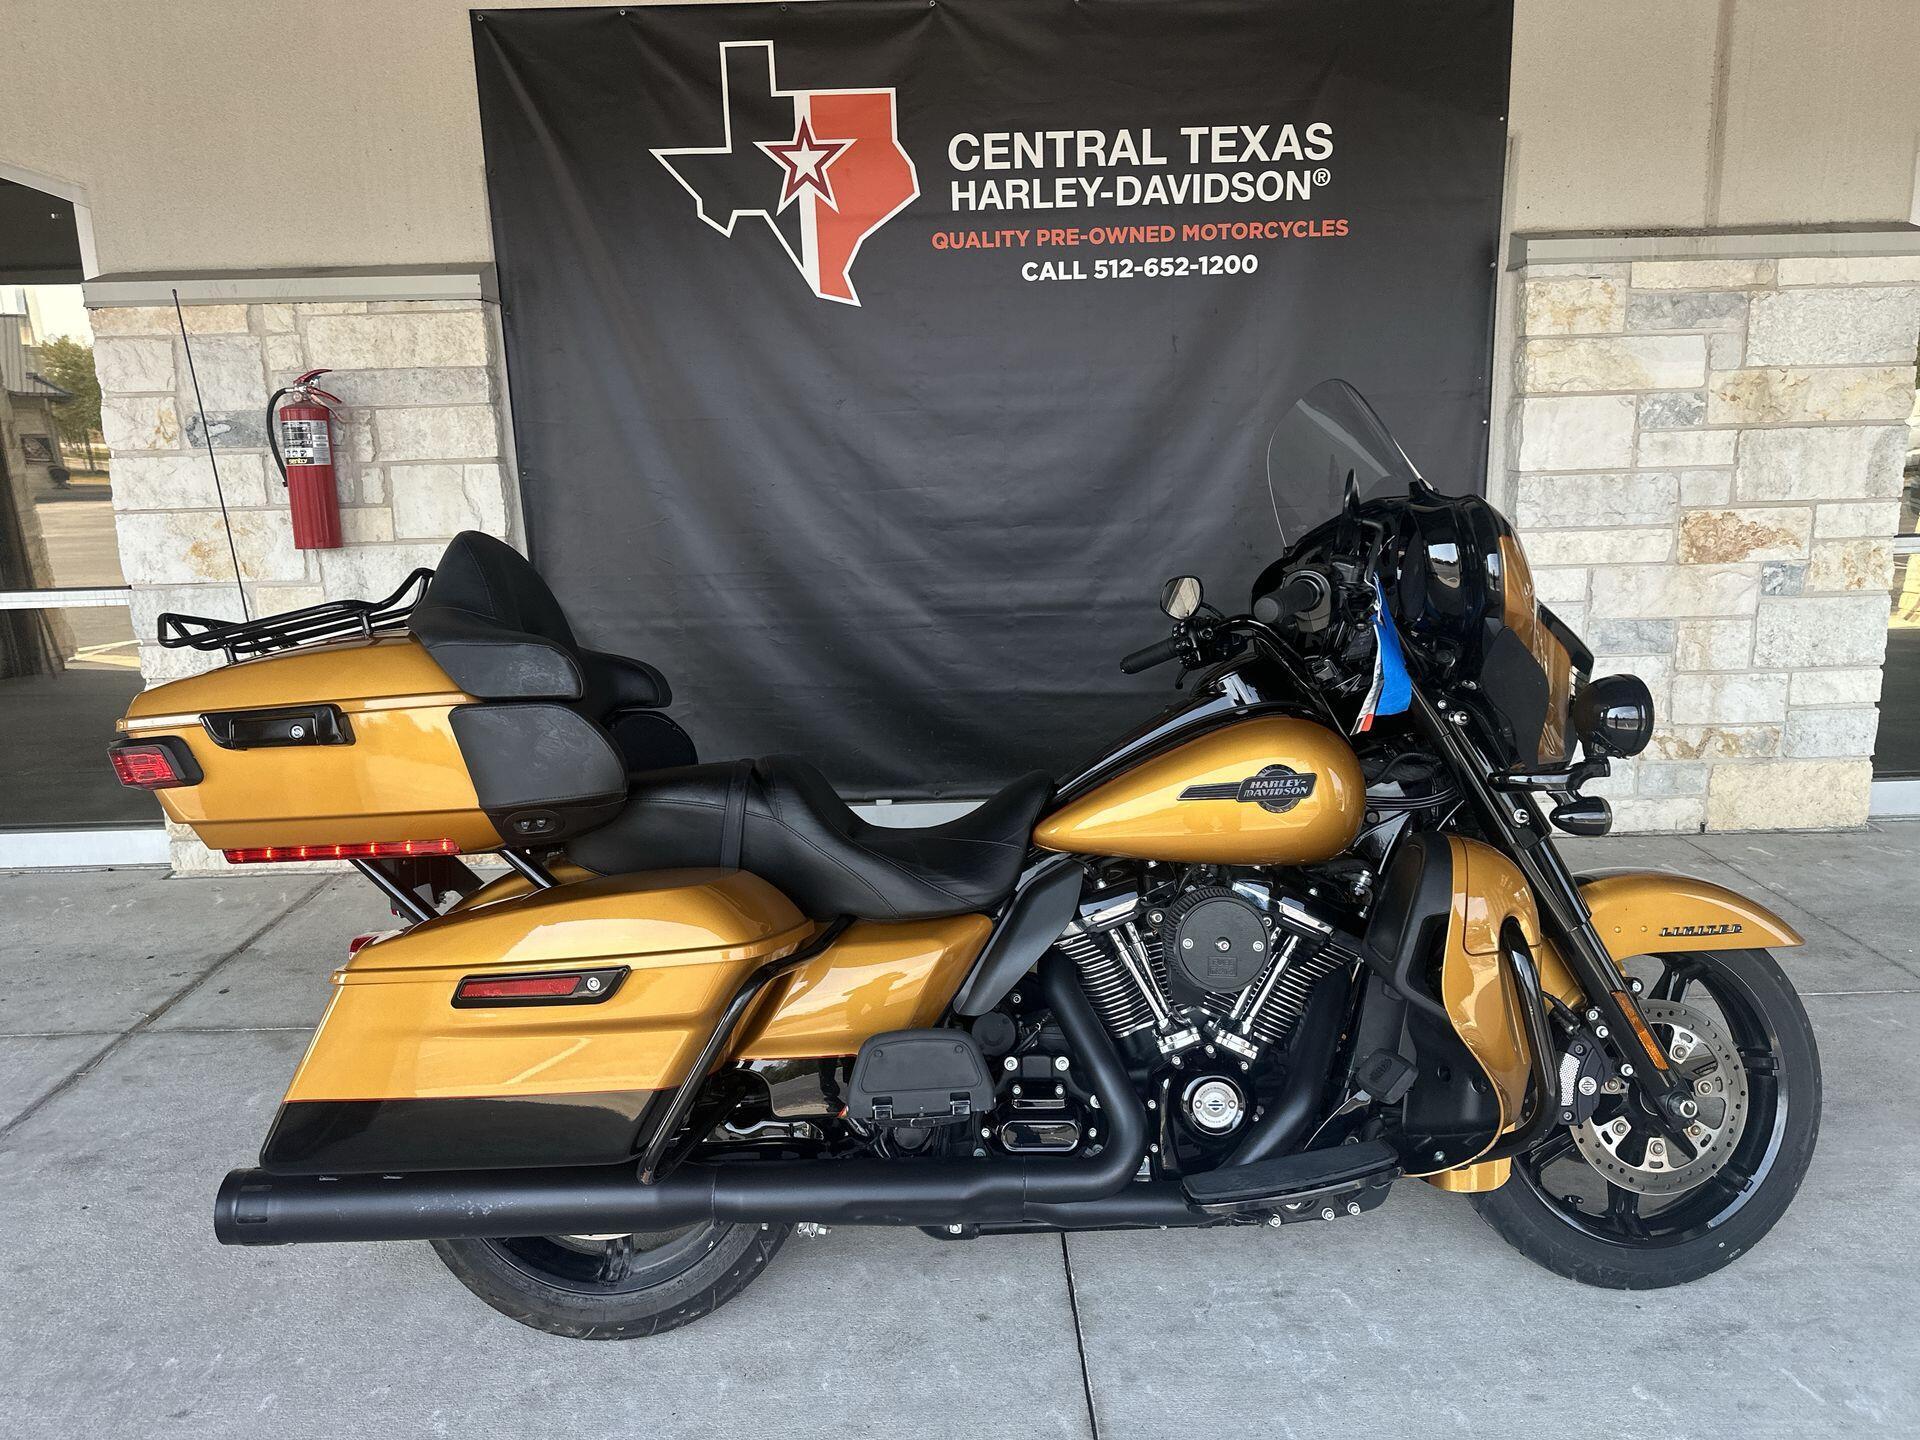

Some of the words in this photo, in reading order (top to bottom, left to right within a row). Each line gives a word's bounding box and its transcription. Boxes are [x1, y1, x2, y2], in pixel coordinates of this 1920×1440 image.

[948, 129, 1167, 171] CENTRAL
[1181, 123, 1333, 163] TEXAS
[932, 230, 1030, 249] QUALITY
[1037, 226, 1175, 246] PRE-OWNED
[1183, 220, 1349, 241] MOTORCYCLES
[1022, 261, 1087, 281] CALL
[1094, 254, 1258, 279] 512-652-1200
[1244, 787, 1308, 797] DAVIDSON
[1250, 779, 1307, 788] HARLEY-
[1659, 924, 1742, 937] LIMITED
